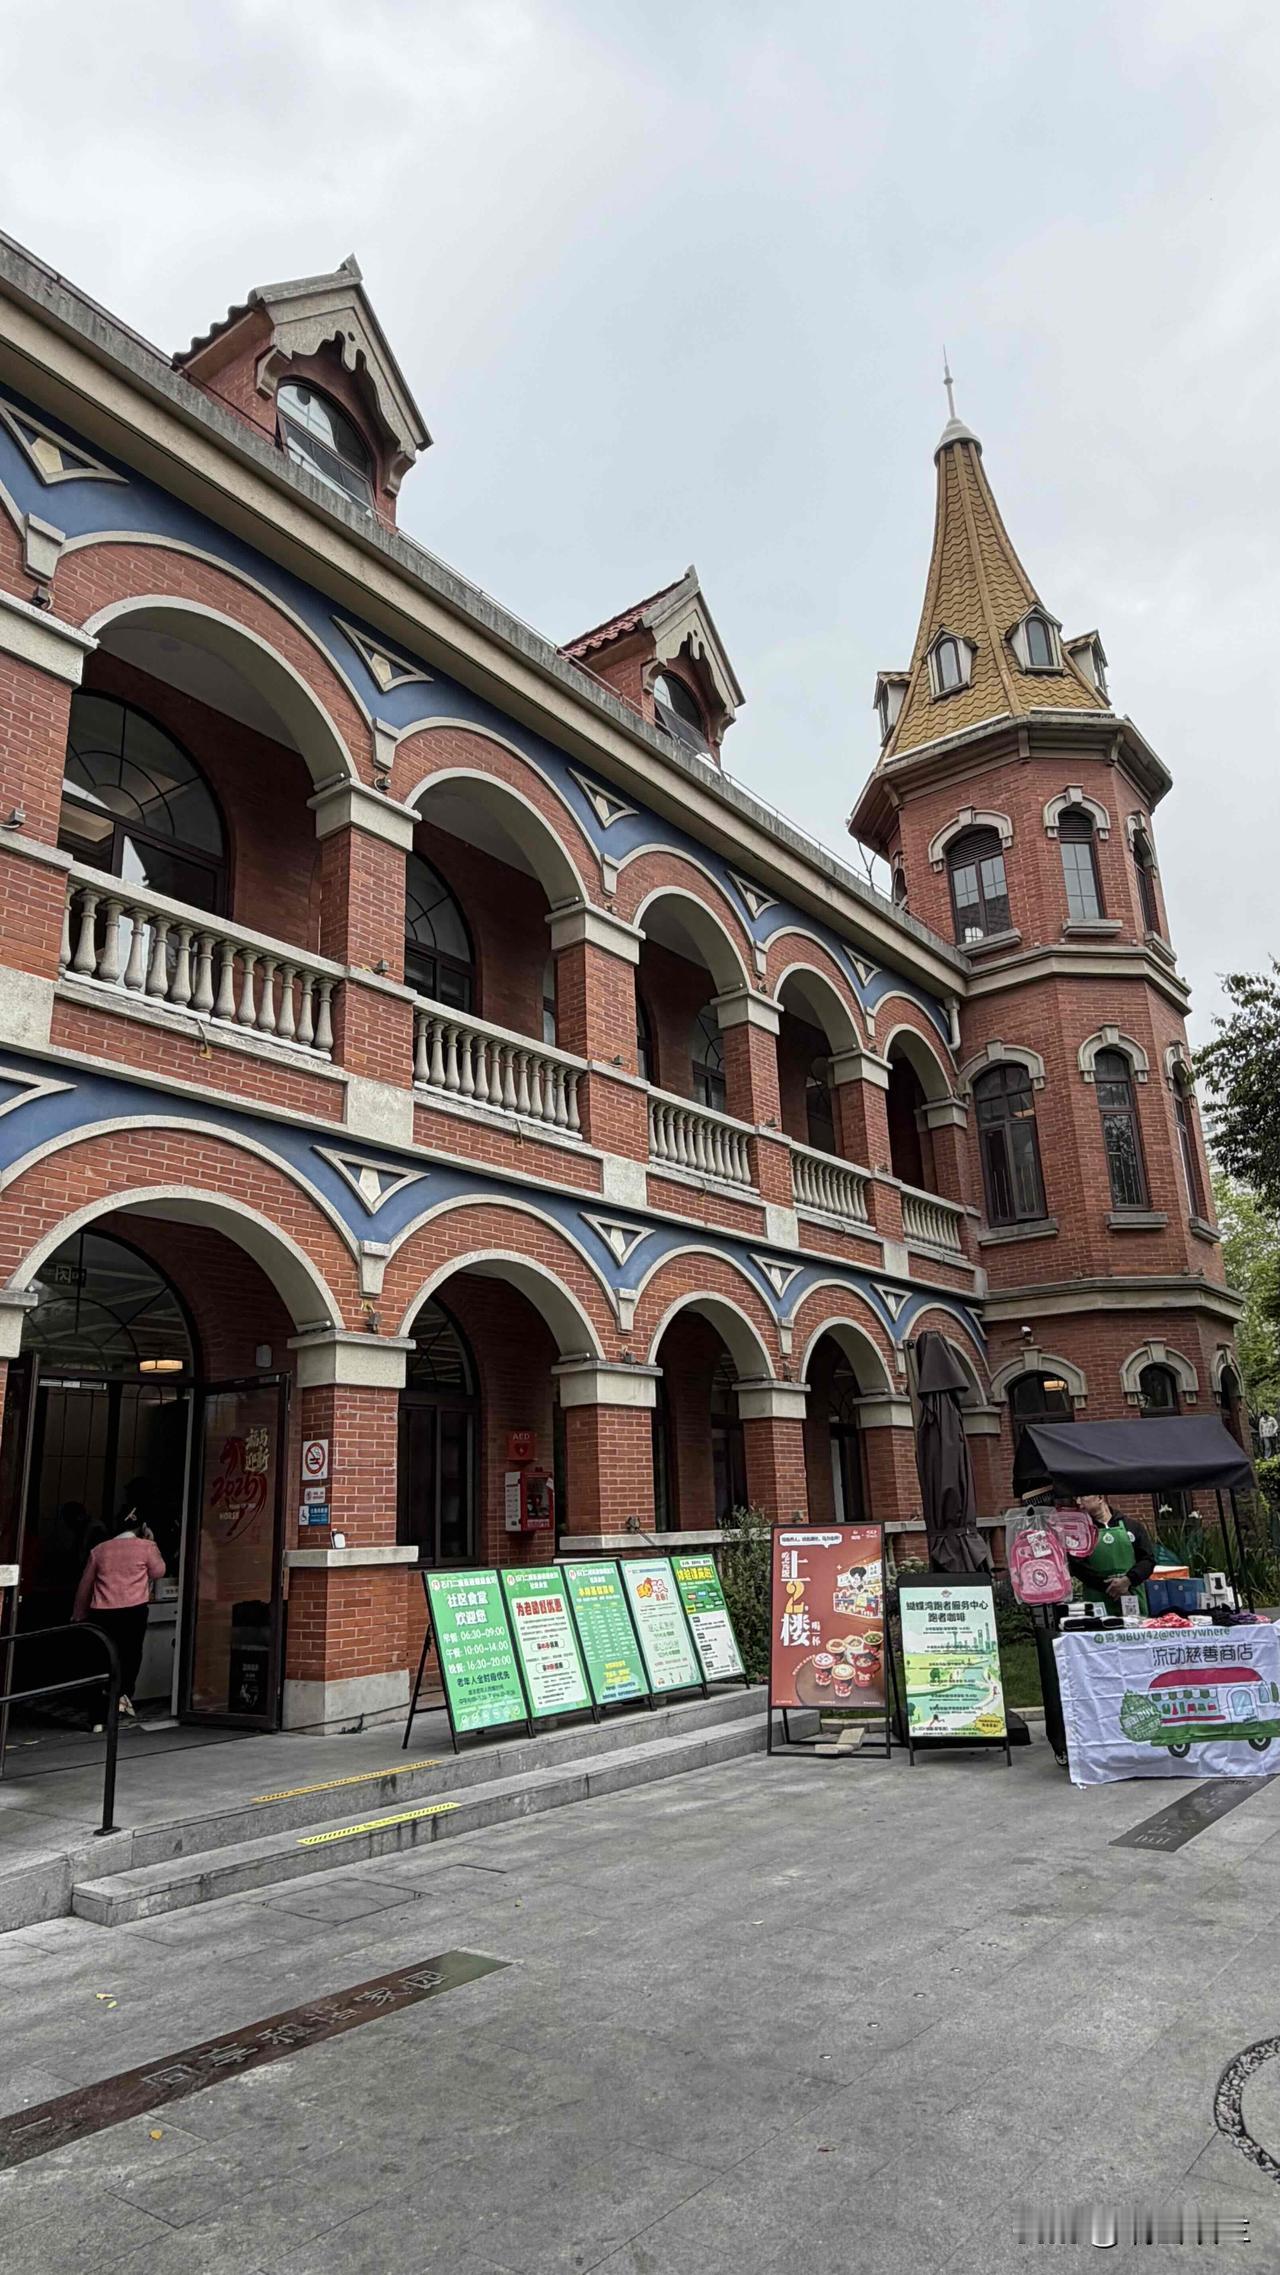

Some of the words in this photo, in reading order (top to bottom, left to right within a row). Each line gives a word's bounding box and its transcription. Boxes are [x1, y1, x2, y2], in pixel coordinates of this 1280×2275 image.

[512, 1432, 530, 1441] AED
[447, 1590, 489, 1608] 社区食堂
[906, 1600, 989, 1611] 蝴蝶湾跑者服务中心
[455, 1608, 487, 1626] 欢迎您
[928, 1612, 966, 1623] 跑者咖啡
[1152, 1643, 1254, 1667] 流动慈善商店
[457, 1670, 511, 1687] 老年人全时段优先
